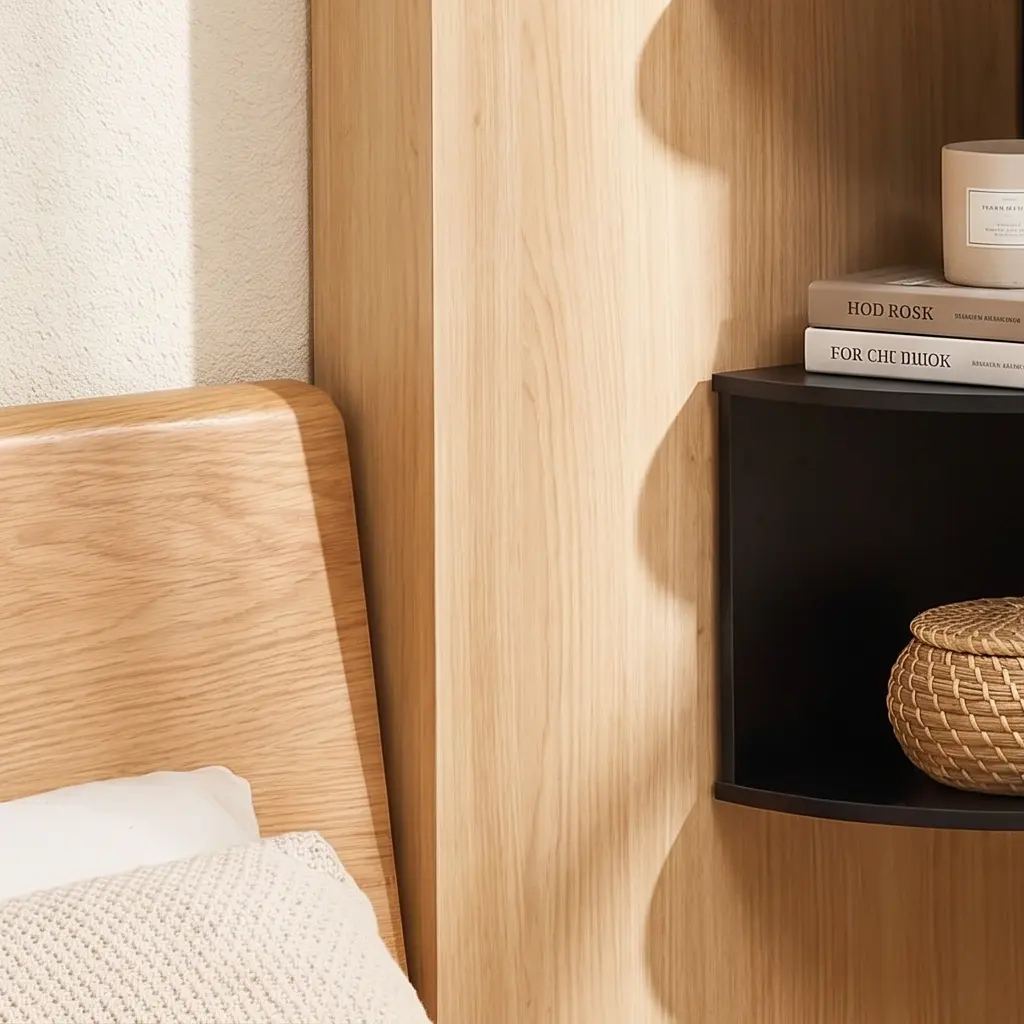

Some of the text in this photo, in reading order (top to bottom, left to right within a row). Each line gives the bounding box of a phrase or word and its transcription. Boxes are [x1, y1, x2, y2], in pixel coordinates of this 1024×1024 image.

[847, 301, 884, 317] HOD
[888, 303, 934, 321] ROSK
[830, 346, 863, 362] FOR
